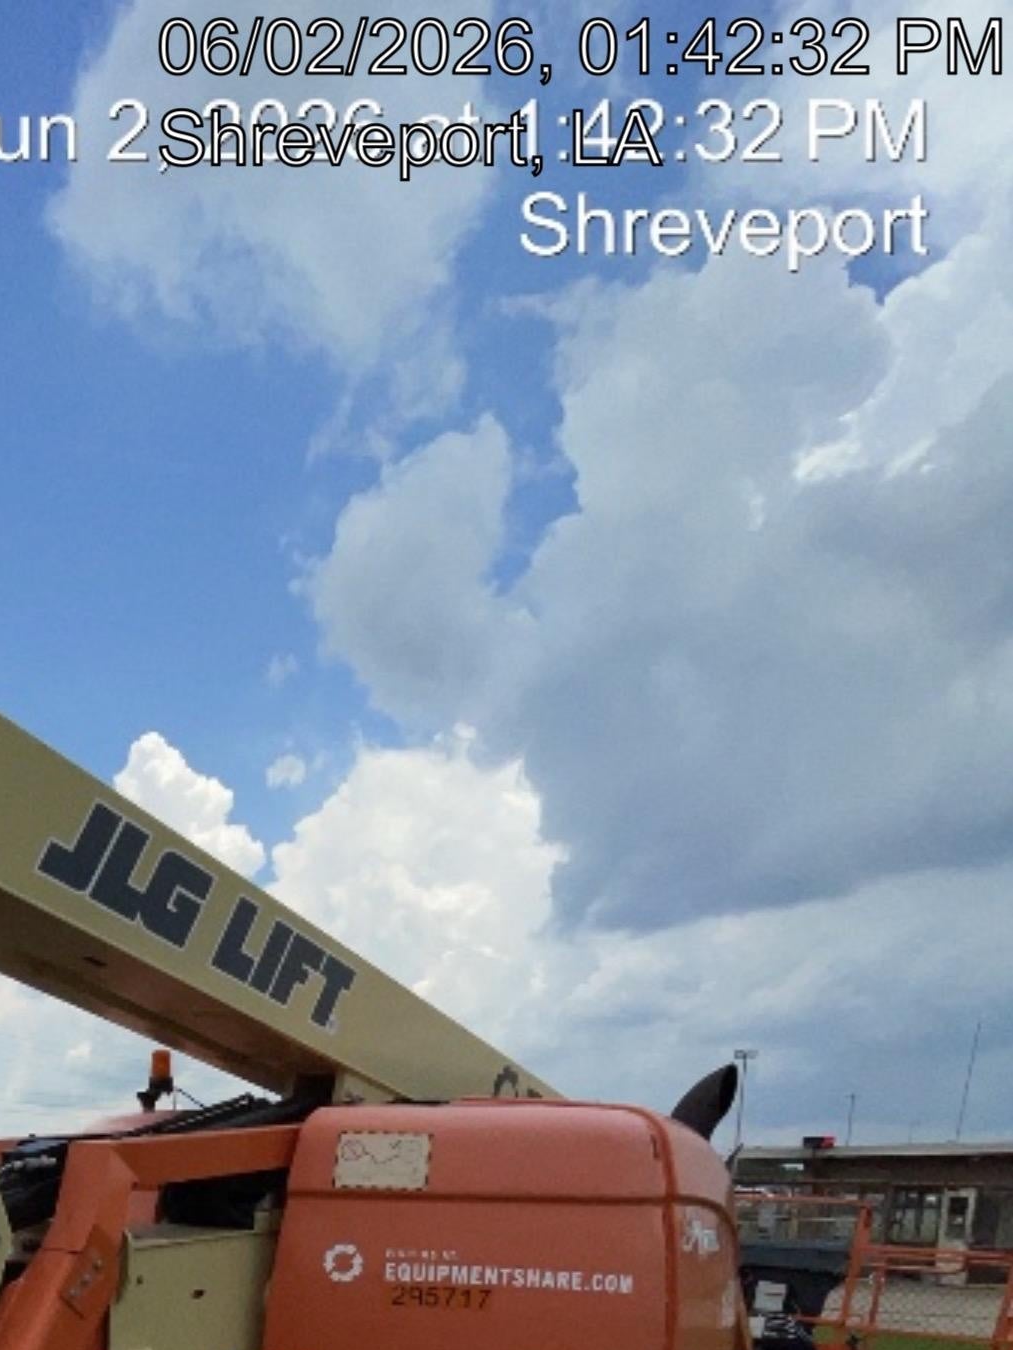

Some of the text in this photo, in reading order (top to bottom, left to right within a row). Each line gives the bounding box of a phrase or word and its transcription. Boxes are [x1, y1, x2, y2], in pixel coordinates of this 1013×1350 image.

[36, 799, 358, 1033] JLG LIFT
[384, 1262, 634, 1294] EQUIPMENTSHARE.COM
